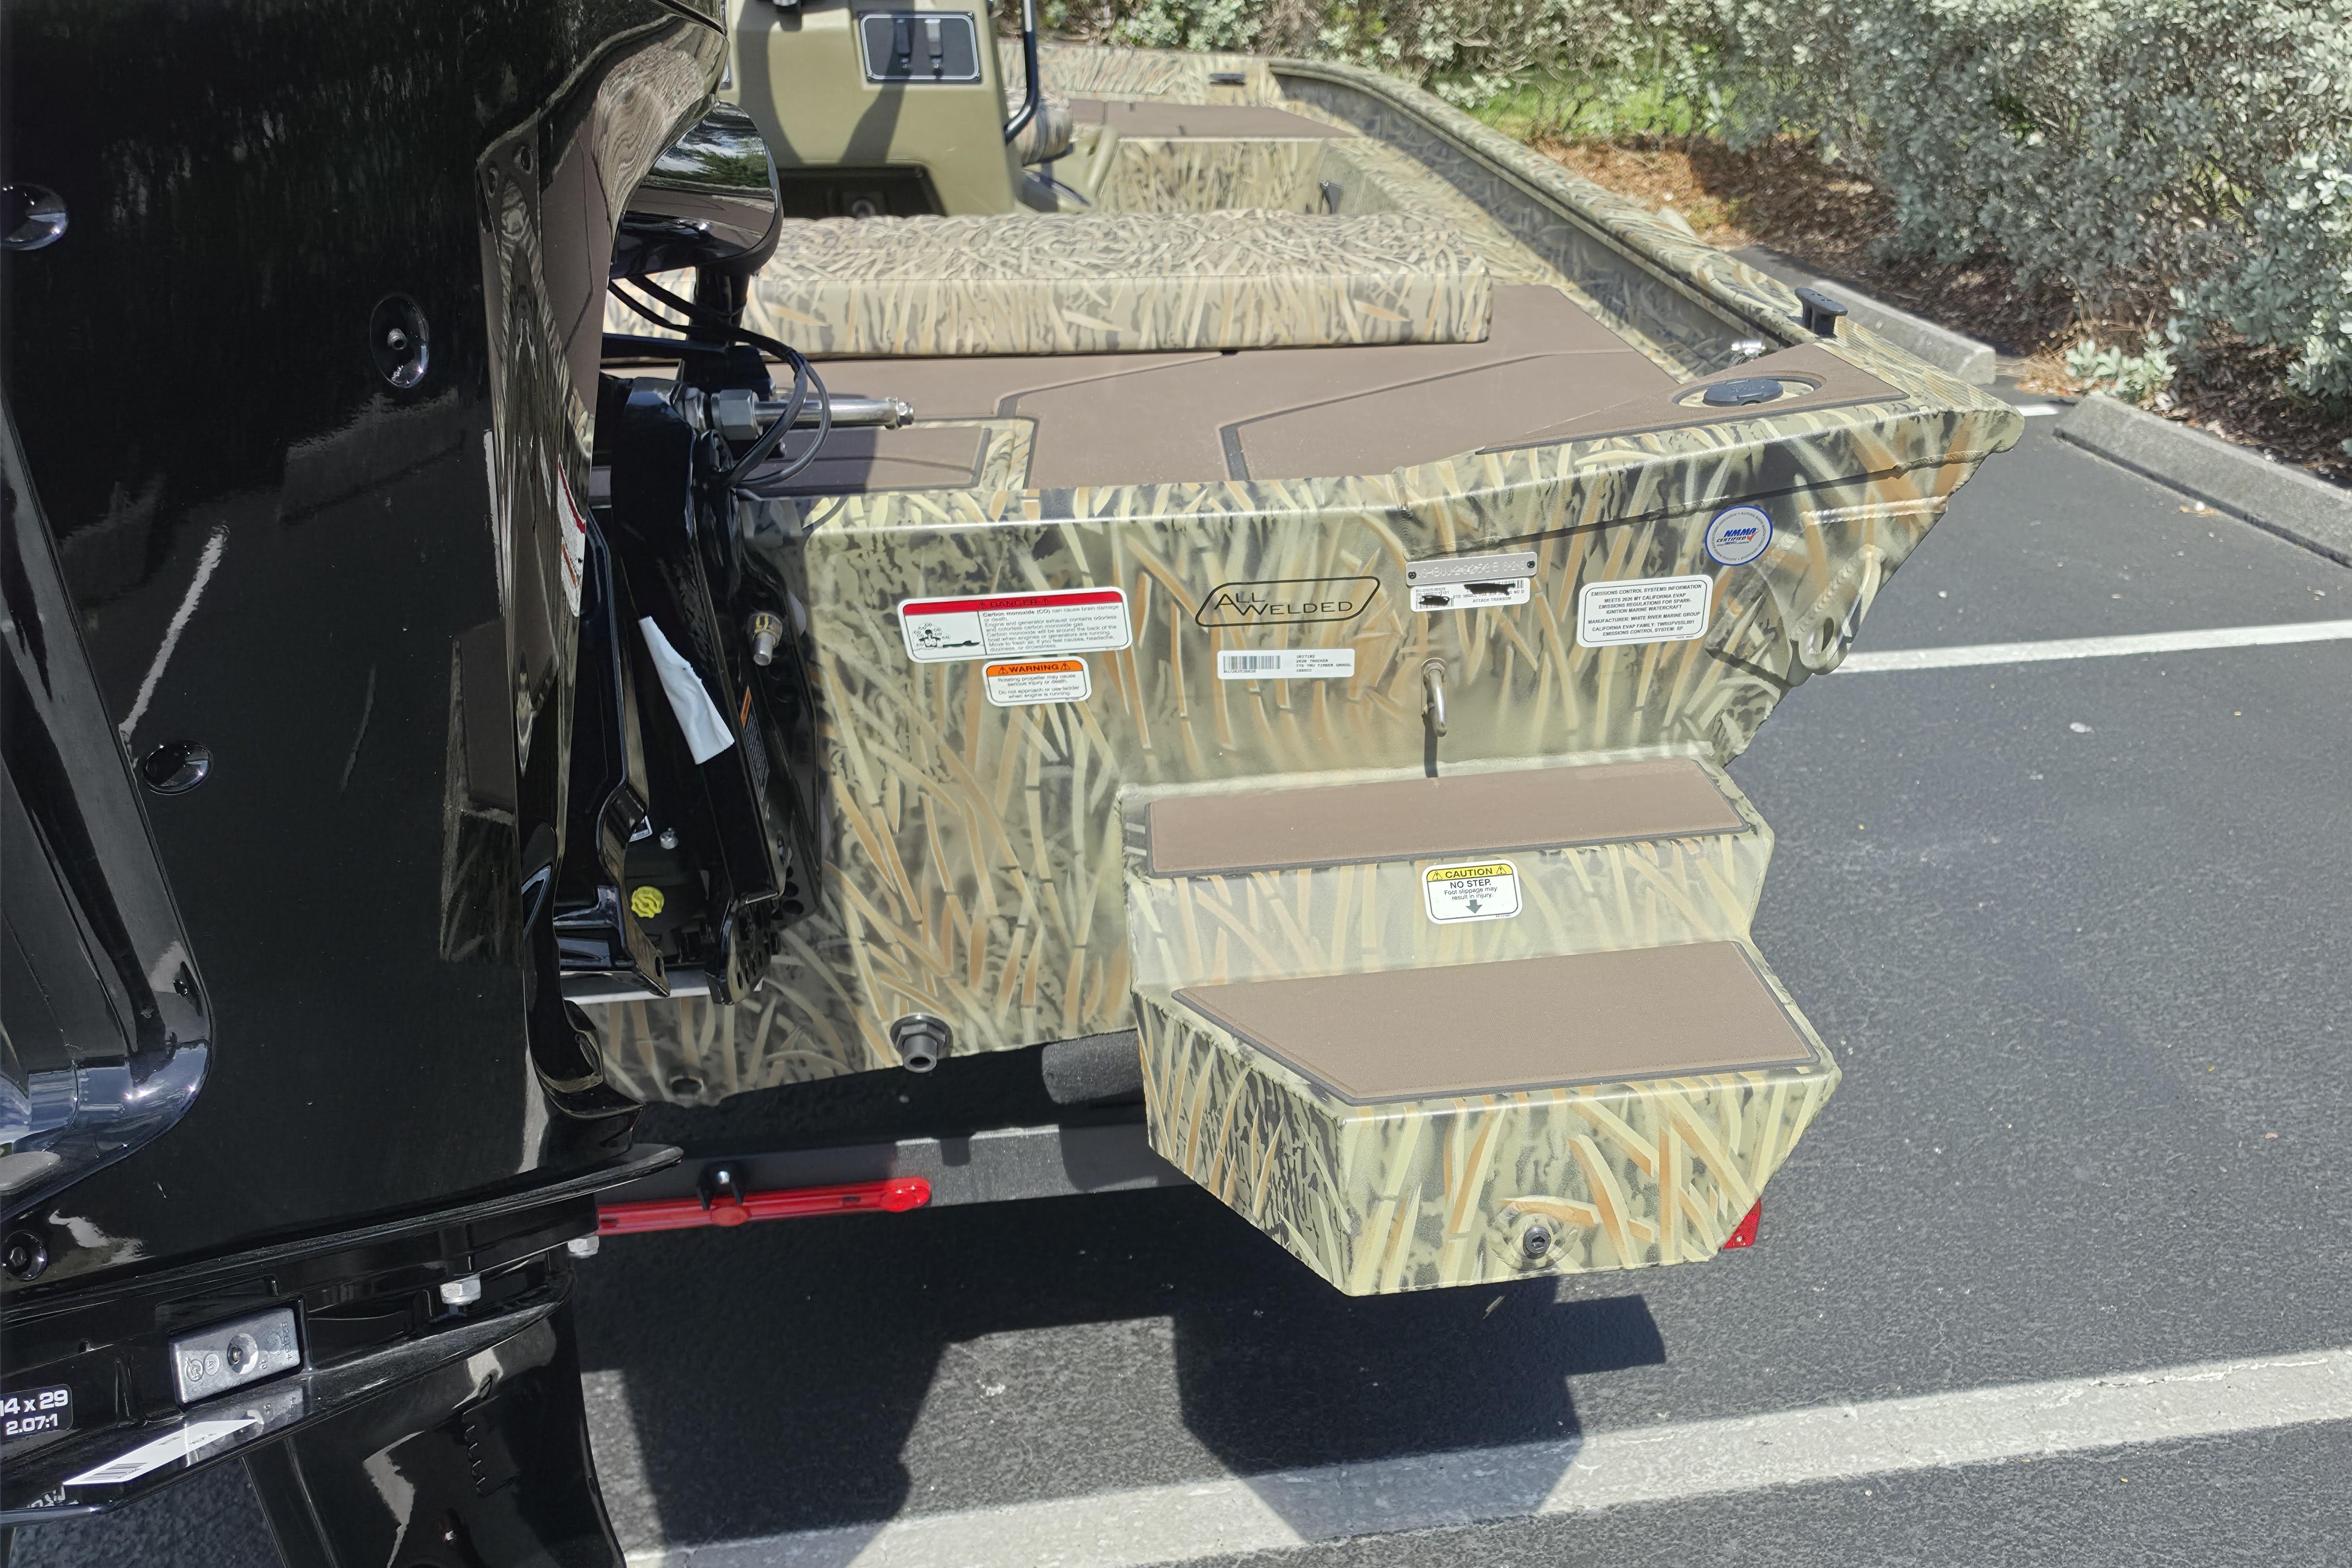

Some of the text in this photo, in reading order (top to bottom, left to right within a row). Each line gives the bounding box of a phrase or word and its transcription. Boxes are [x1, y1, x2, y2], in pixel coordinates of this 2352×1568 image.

[1723, 528, 1757, 537] NMMA
[990, 599, 1037, 607] DANGER
[1214, 592, 1265, 610] ALL
[1233, 601, 1353, 616] WELDED
[1009, 664, 1059, 673] WARNING
[1445, 868, 1493, 878] CAUTION
[1467, 879, 1491, 887] STEP.
[24, 1399, 36, 1412] x
[40, 1390, 68, 1410] 29
[6, 1413, 58, 1435] 2.07:1
